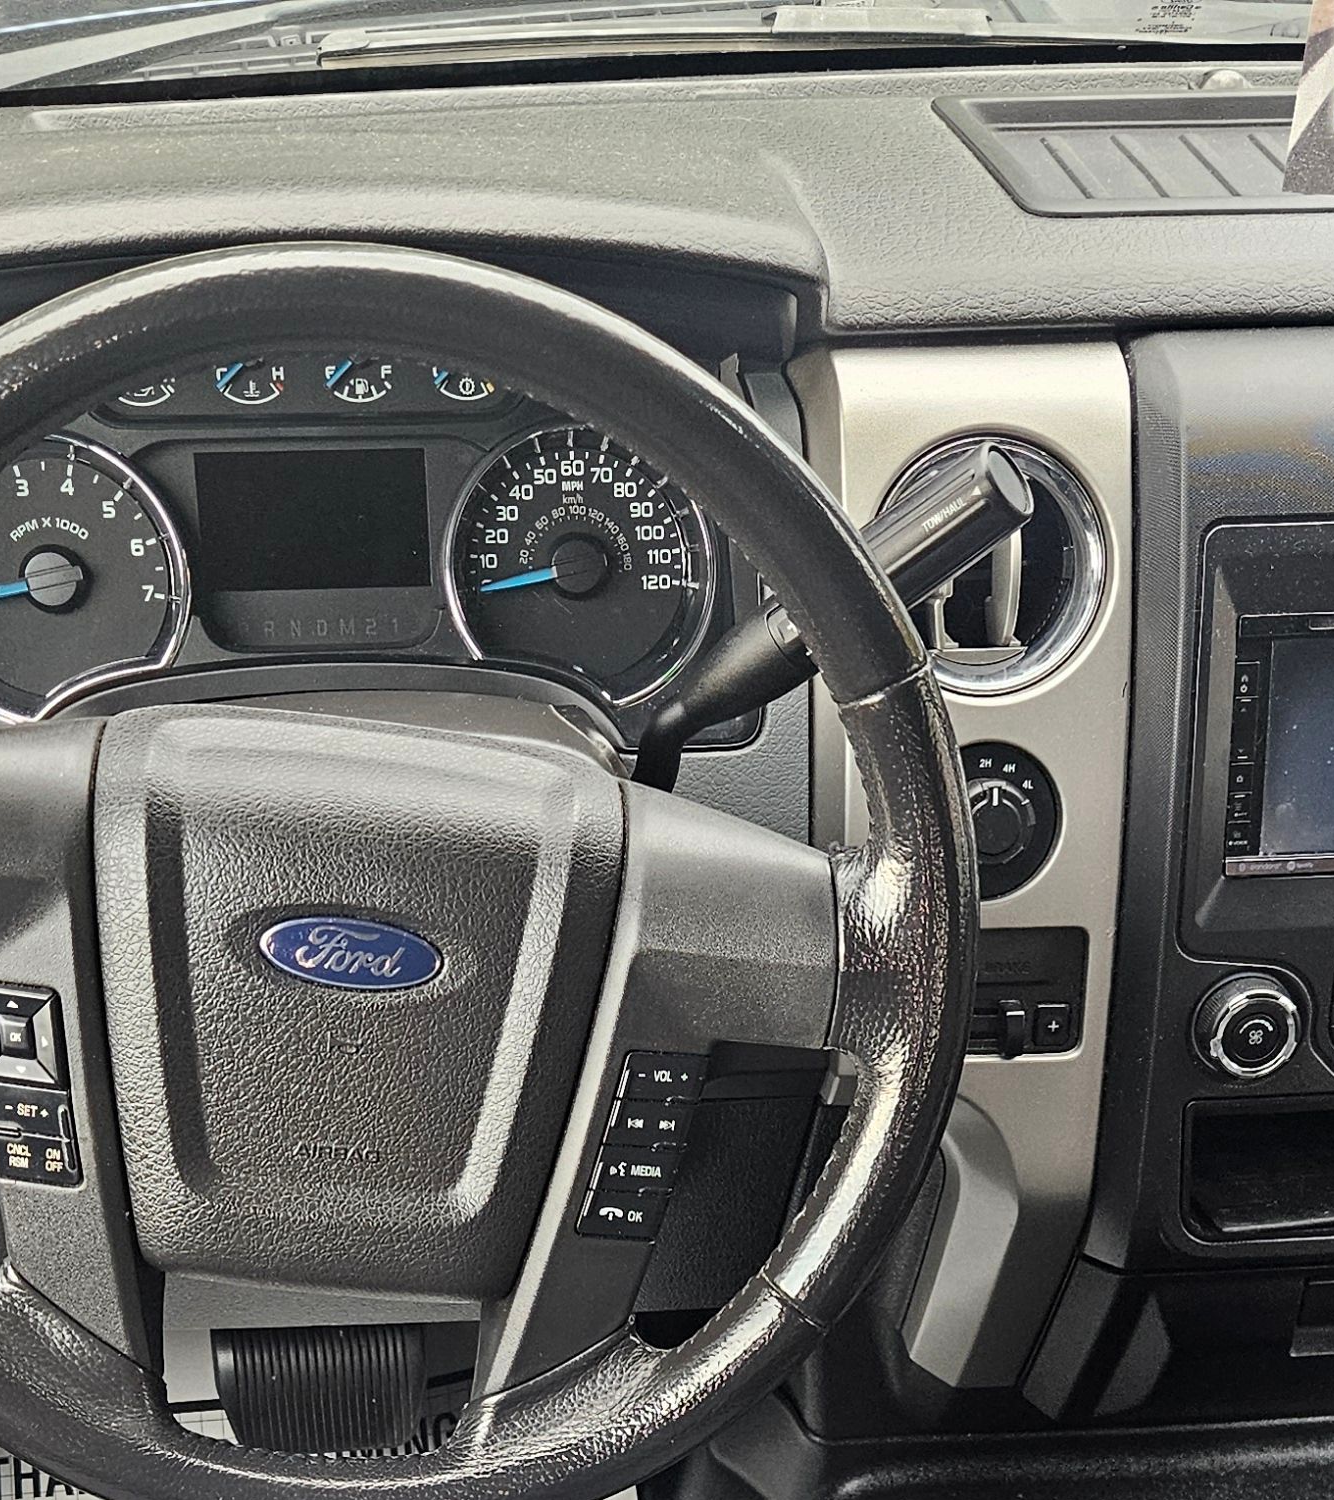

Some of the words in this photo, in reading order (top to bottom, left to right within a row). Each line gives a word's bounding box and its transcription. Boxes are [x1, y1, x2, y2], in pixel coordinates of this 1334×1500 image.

[272, 366, 285, 380] H
[381, 365, 392, 380] F
[560, 460, 585, 476] 60
[590, 467, 613, 483] 70
[533, 468, 557, 485] 50
[16, 479, 30, 497] 3
[59, 478, 75, 496] 4
[508, 484, 534, 501] 40
[561, 481, 584, 492] MPH
[613, 482, 637, 498] 80
[562, 493, 584, 504] km/h
[101, 501, 117, 519] 5
[495, 505, 519, 521] 30
[550, 506, 566, 519] 80
[568, 505, 587, 515] 100
[587, 508, 605, 523] 120
[629, 502, 654, 518] 90
[921, 496, 967, 532] TOW/HAUL
[9, 518, 39, 543] RPM
[42, 516, 53, 528] X
[55, 517, 90, 541] 1000
[534, 515, 550, 531] 60
[603, 517, 621, 536] 140
[485, 528, 509, 544] 20
[524, 530, 536, 546] 40
[634, 525, 665, 541] 100
[130, 539, 145, 557] 6
[479, 554, 498, 569] 10
[519, 549, 529, 565] 20
[647, 549, 672, 564] 110
[641, 574, 671, 590] 120
[141, 584, 155, 602] 7
[290, 619, 302, 637] N
[317, 619, 328, 636] D
[339, 618, 355, 635] M
[365, 618, 377, 635] 2
[979, 758, 992, 769] 2H
[1002, 763, 1016, 773] 4H
[1022, 780, 1034, 790] 4L
[295, 925, 405, 978] Ford
[9, 1031, 22, 1042] OK
[653, 1070, 672, 1083] VOL
[17, 1102, 38, 1118] SET
[6, 1142, 32, 1157] CNCL
[45, 1148, 61, 1160] ON
[8, 1155, 29, 1169] RSM
[45, 1160, 64, 1173] OFF
[630, 1164, 662, 1178] MEDIA
[627, 1210, 643, 1223] OK
